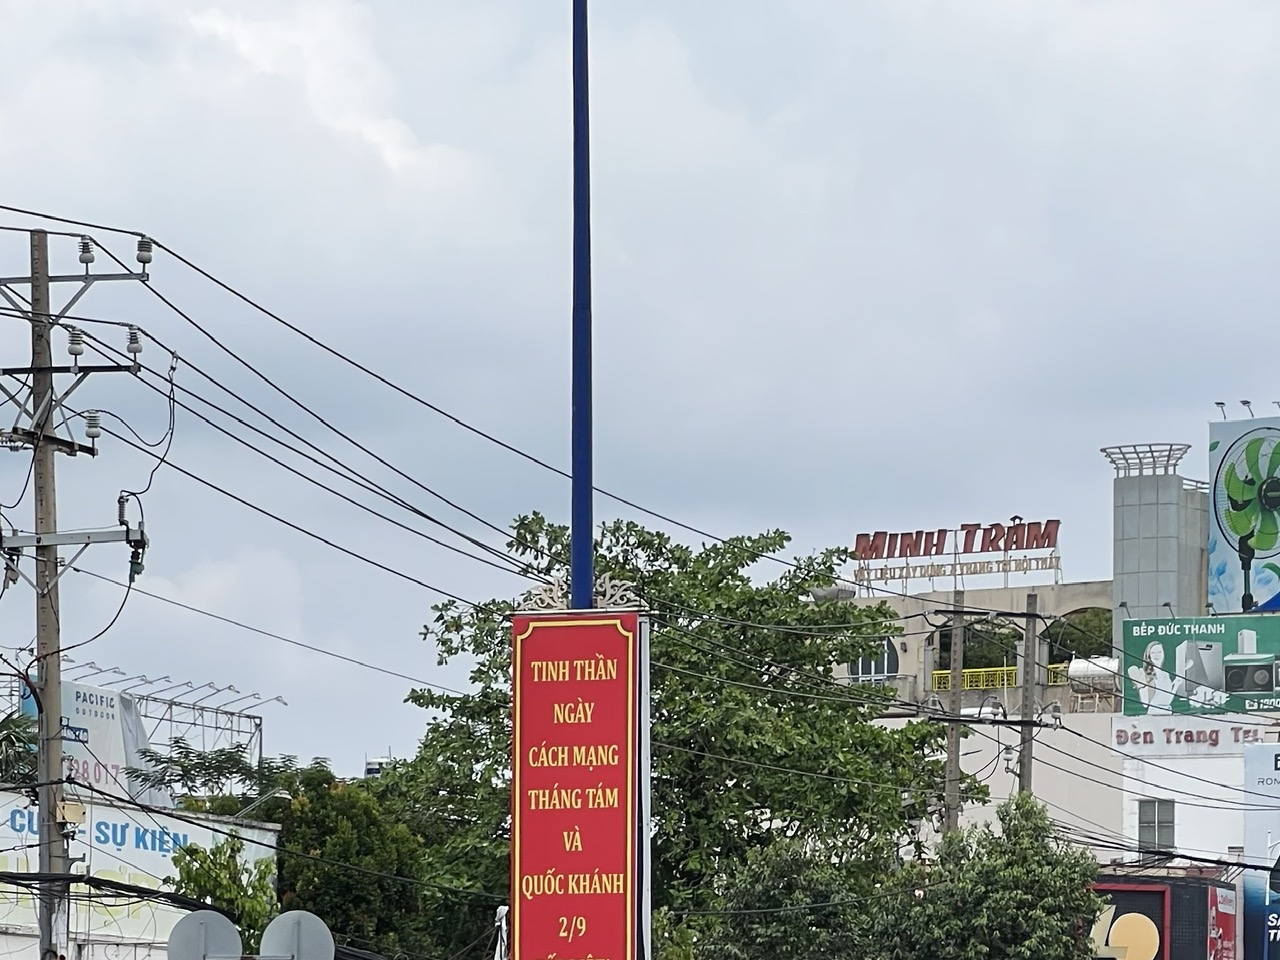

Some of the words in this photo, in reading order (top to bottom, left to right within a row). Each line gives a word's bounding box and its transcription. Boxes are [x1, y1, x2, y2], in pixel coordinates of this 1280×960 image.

[855, 529, 948, 560] MINH
[960, 515, 1062, 554] TRÂM
[1132, 621, 1155, 636] BẾP
[1157, 622, 1181, 635] ĐỨC
[1183, 623, 1225, 635] THANH
[531, 661, 569, 682] TINH
[574, 653, 617, 681] THẦN
[75, 690, 115, 709] PACIFIC
[554, 698, 594, 723] NGÀY
[75, 707, 115, 720] OUTDOOR
[1116, 724, 1155, 745] Đèn
[1163, 728, 1220, 746] Trang
[528, 741, 569, 767] CÁCH
[573, 745, 619, 771] MẠNG
[528, 783, 582, 809] THÁNG
[586, 782, 619, 808] TÁM
[95, 820, 130, 851] SỰ
[134, 825, 188, 857] KIỆN
[563, 825, 582, 851] VÀ
[522, 868, 564, 900] QUỐC
[568, 868, 624, 894] KHÁNH
[558, 916, 586, 942] 2/9
